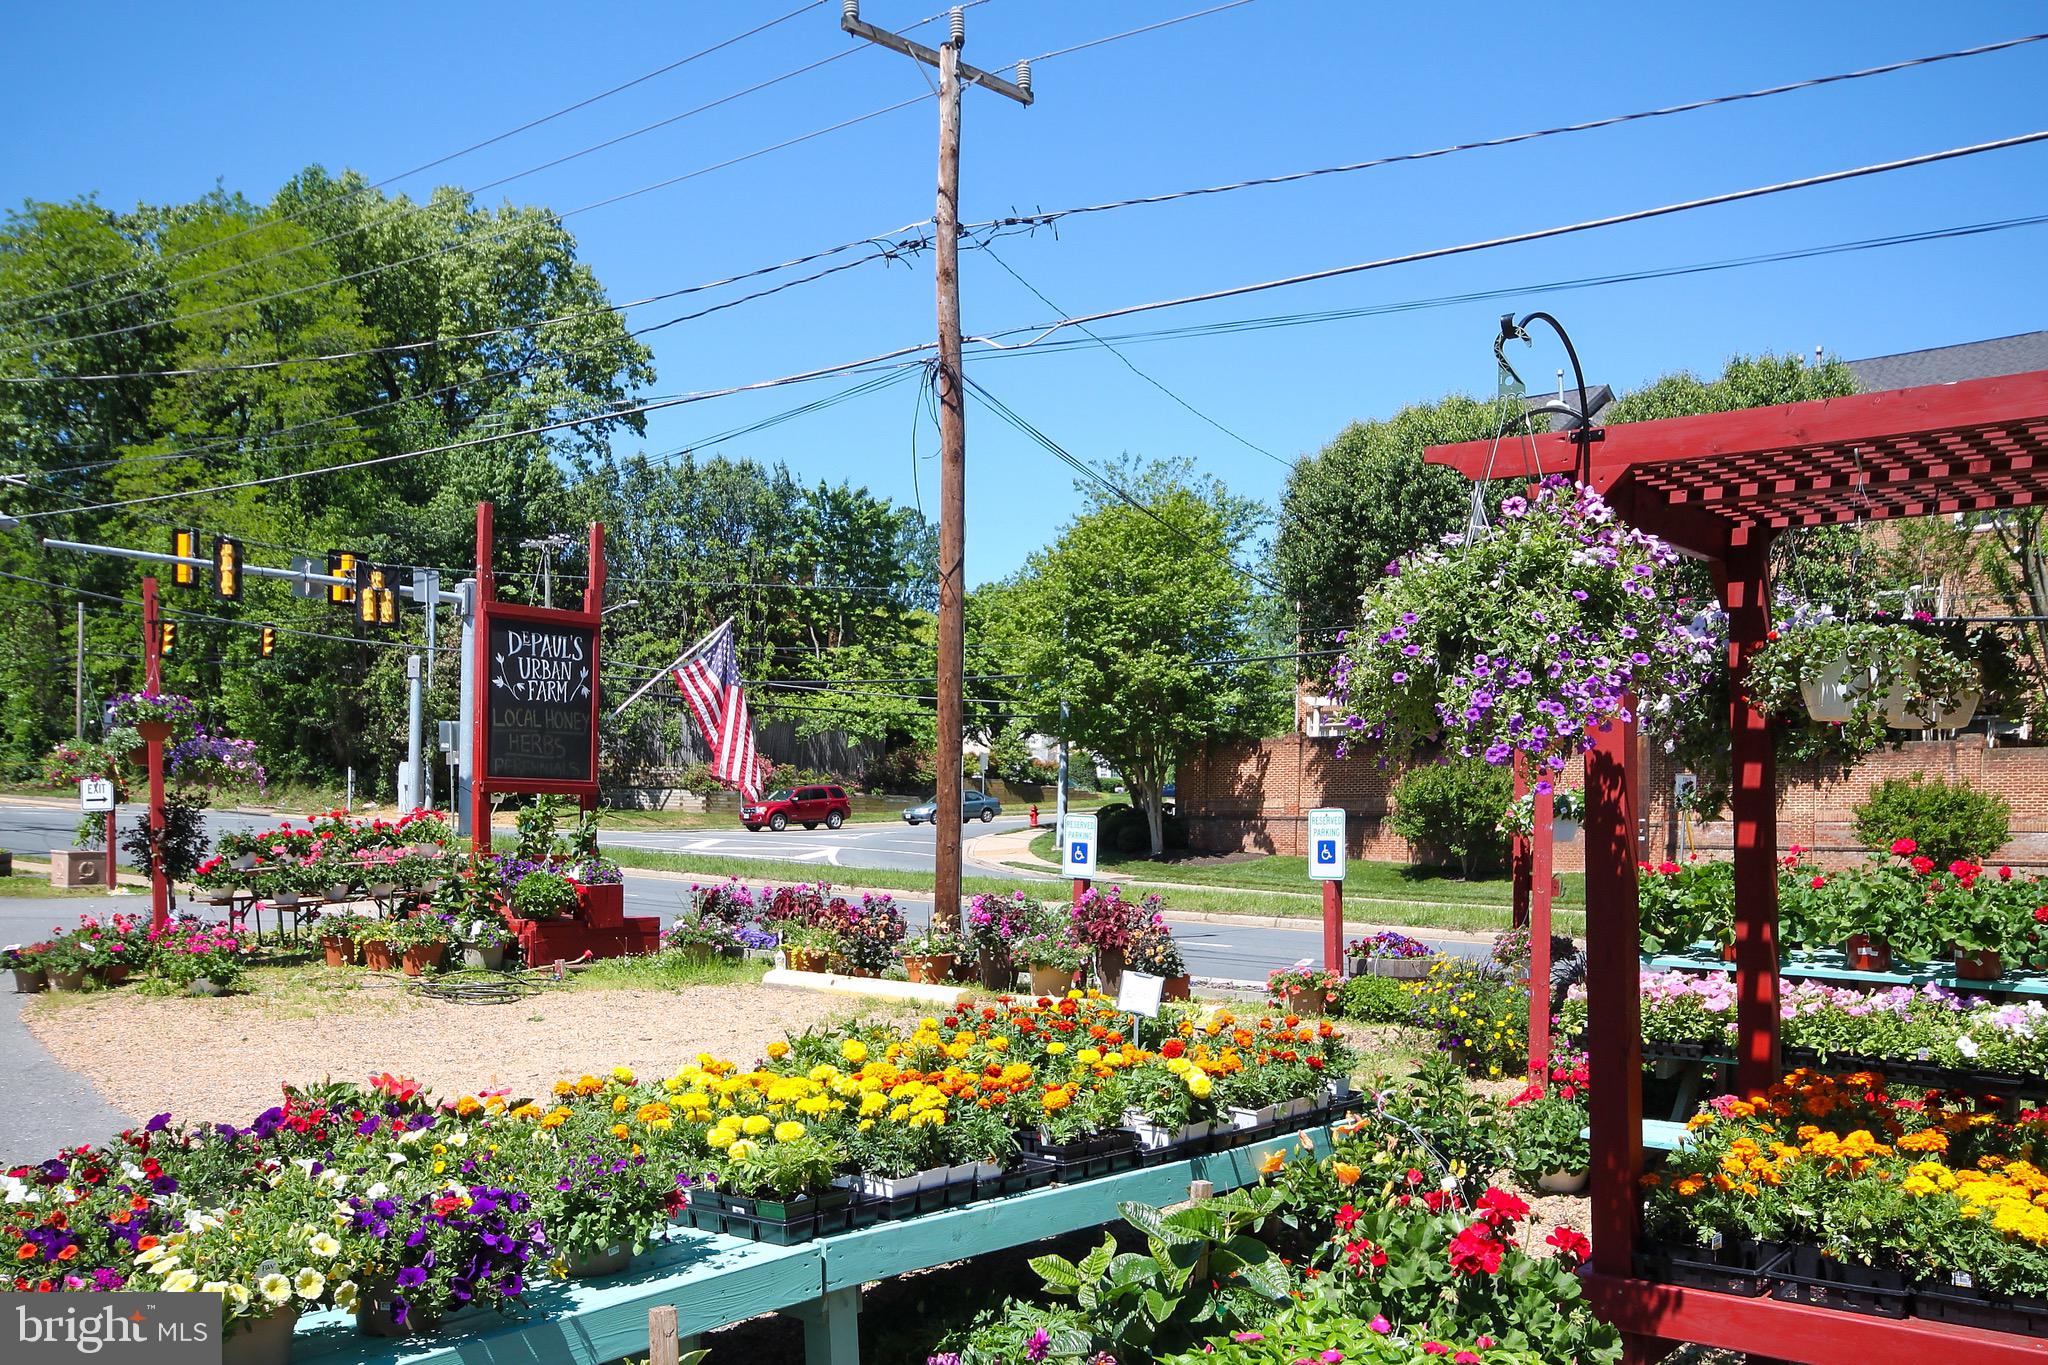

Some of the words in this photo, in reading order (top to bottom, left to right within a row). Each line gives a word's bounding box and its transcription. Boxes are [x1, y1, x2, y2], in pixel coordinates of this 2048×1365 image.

[518, 656, 572, 681] URBAN
[527, 680, 569, 703] FARM
[492, 707, 542, 728] LOCAL
[545, 708, 590, 731] HONEY
[508, 733, 566, 759] HERBS
[87, 782, 106, 795] EXIT
[1311, 816, 1343, 826] RESERVED
[1313, 827, 1341, 837] PARKING
